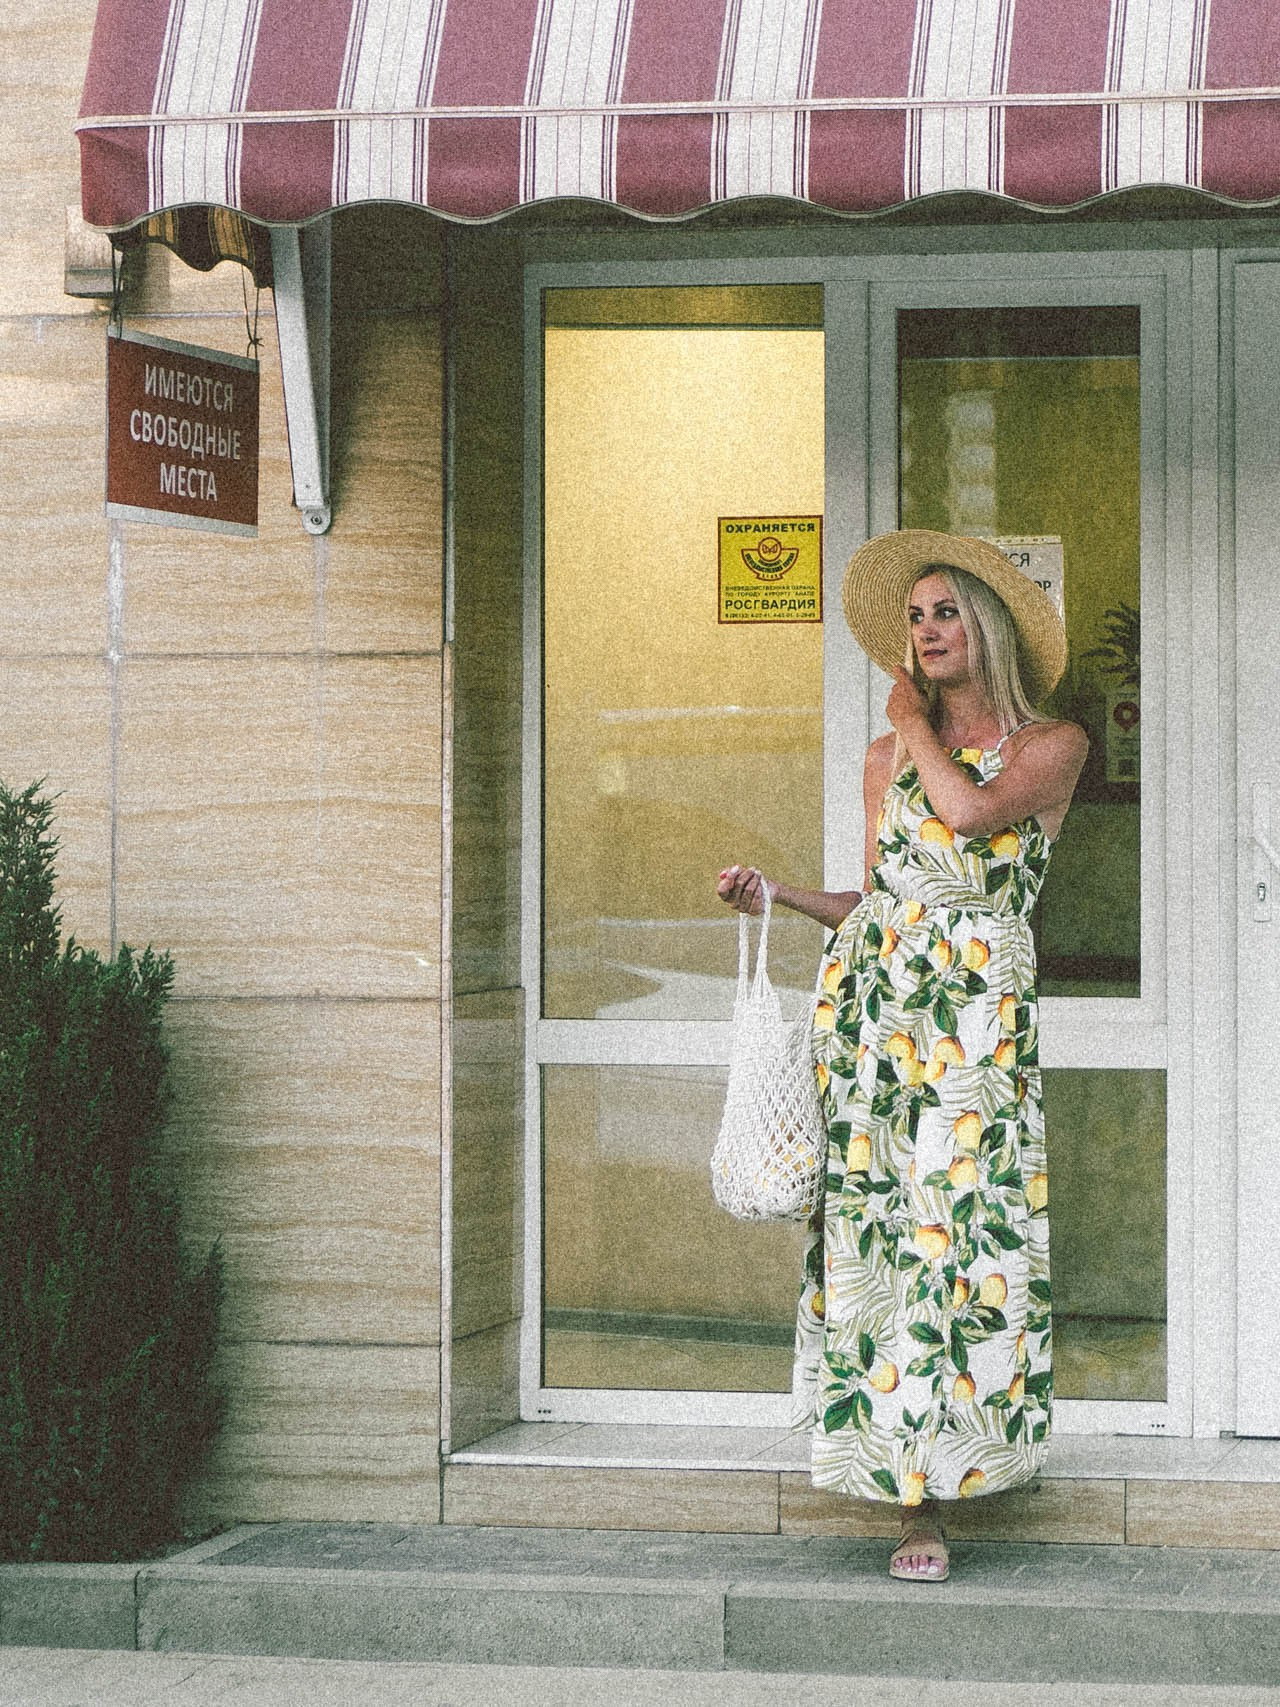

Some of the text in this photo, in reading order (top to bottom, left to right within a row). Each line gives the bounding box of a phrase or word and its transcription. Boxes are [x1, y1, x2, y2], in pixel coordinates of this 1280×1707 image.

[145, 363, 234, 413] ИМЕЮТСЯ
[130, 408, 241, 461] СВОБОДНЫЕ
[160, 462, 218, 502] МЕСТА
[725, 523, 815, 534] ОХРАНЯЕТСЯ
[725, 599, 815, 611] РОСГВАРДИЯ
